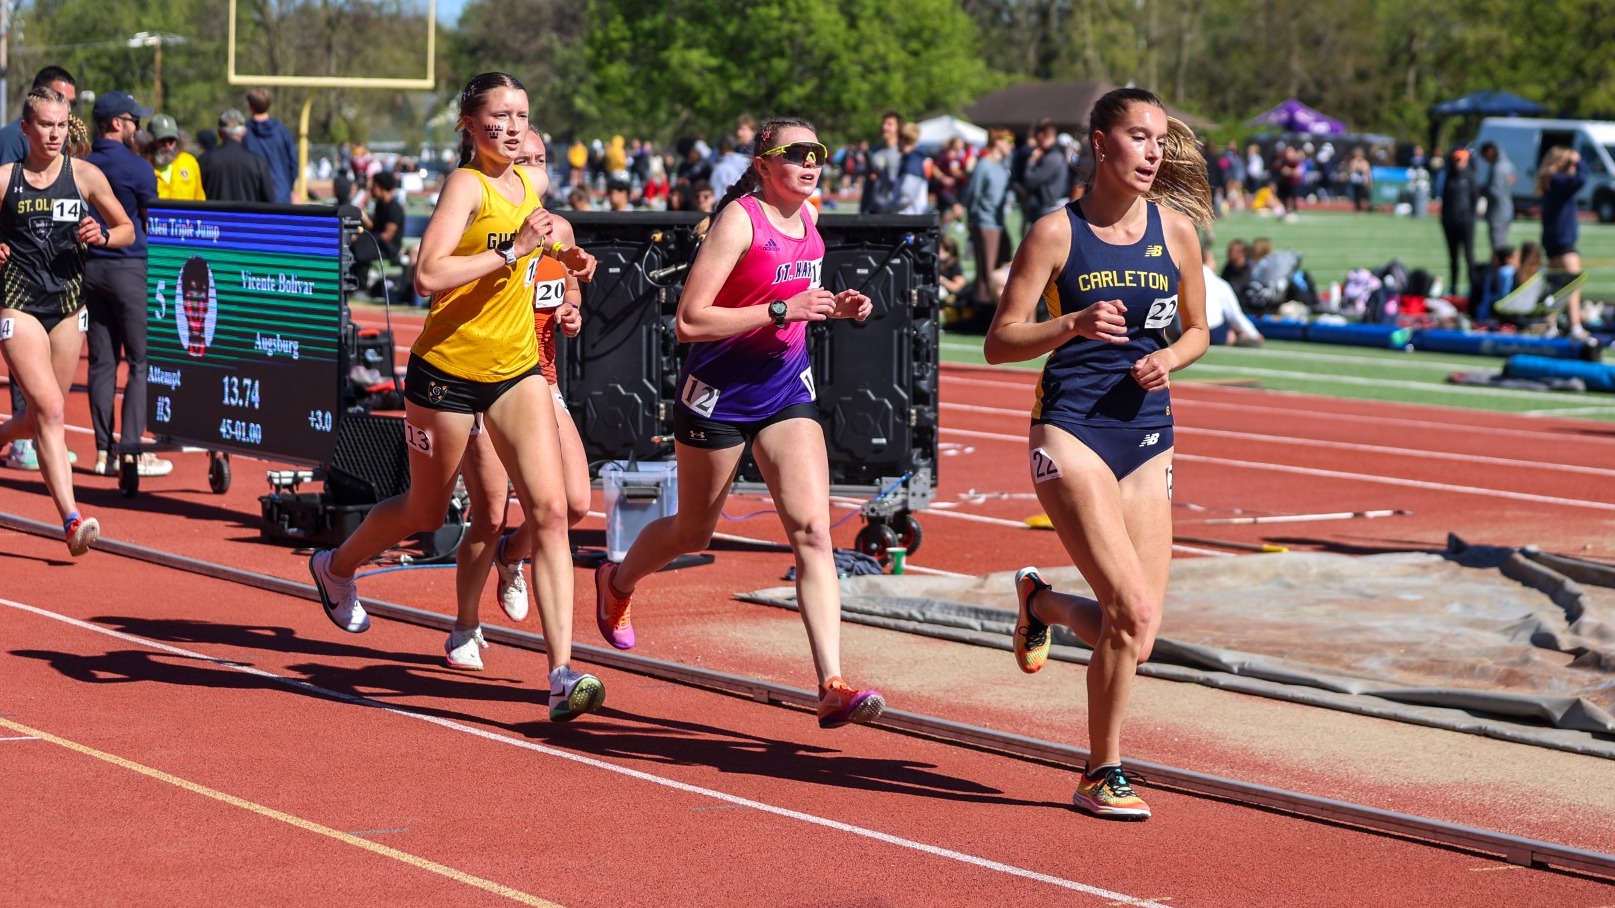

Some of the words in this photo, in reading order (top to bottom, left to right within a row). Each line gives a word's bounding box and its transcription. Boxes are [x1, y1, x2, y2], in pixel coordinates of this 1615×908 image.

[18, 200, 34, 214] ST.
[56, 202, 79, 218] 14
[148, 217, 168, 236] Men
[168, 218, 195, 242] Triple
[195, 219, 220, 243] Jump
[240, 270, 276, 292] Vicente
[774, 263, 793, 283] ST.
[811, 261, 822, 283] 1
[1078, 270, 1169, 292] CARLETON
[154, 280, 167, 319] 5
[538, 281, 565, 301] 20
[1147, 299, 1177, 321] 22
[253, 332, 300, 360] Augsburg
[147, 365, 182, 391] Attempt
[222, 374, 261, 410] 13.74
[683, 379, 715, 413] 12
[156, 396, 172, 423] #3
[308, 409, 333, 433] +3.0
[219, 418, 262, 445] 45-01.00
[407, 425, 430, 451] 13
[1033, 451, 1059, 479] 22
